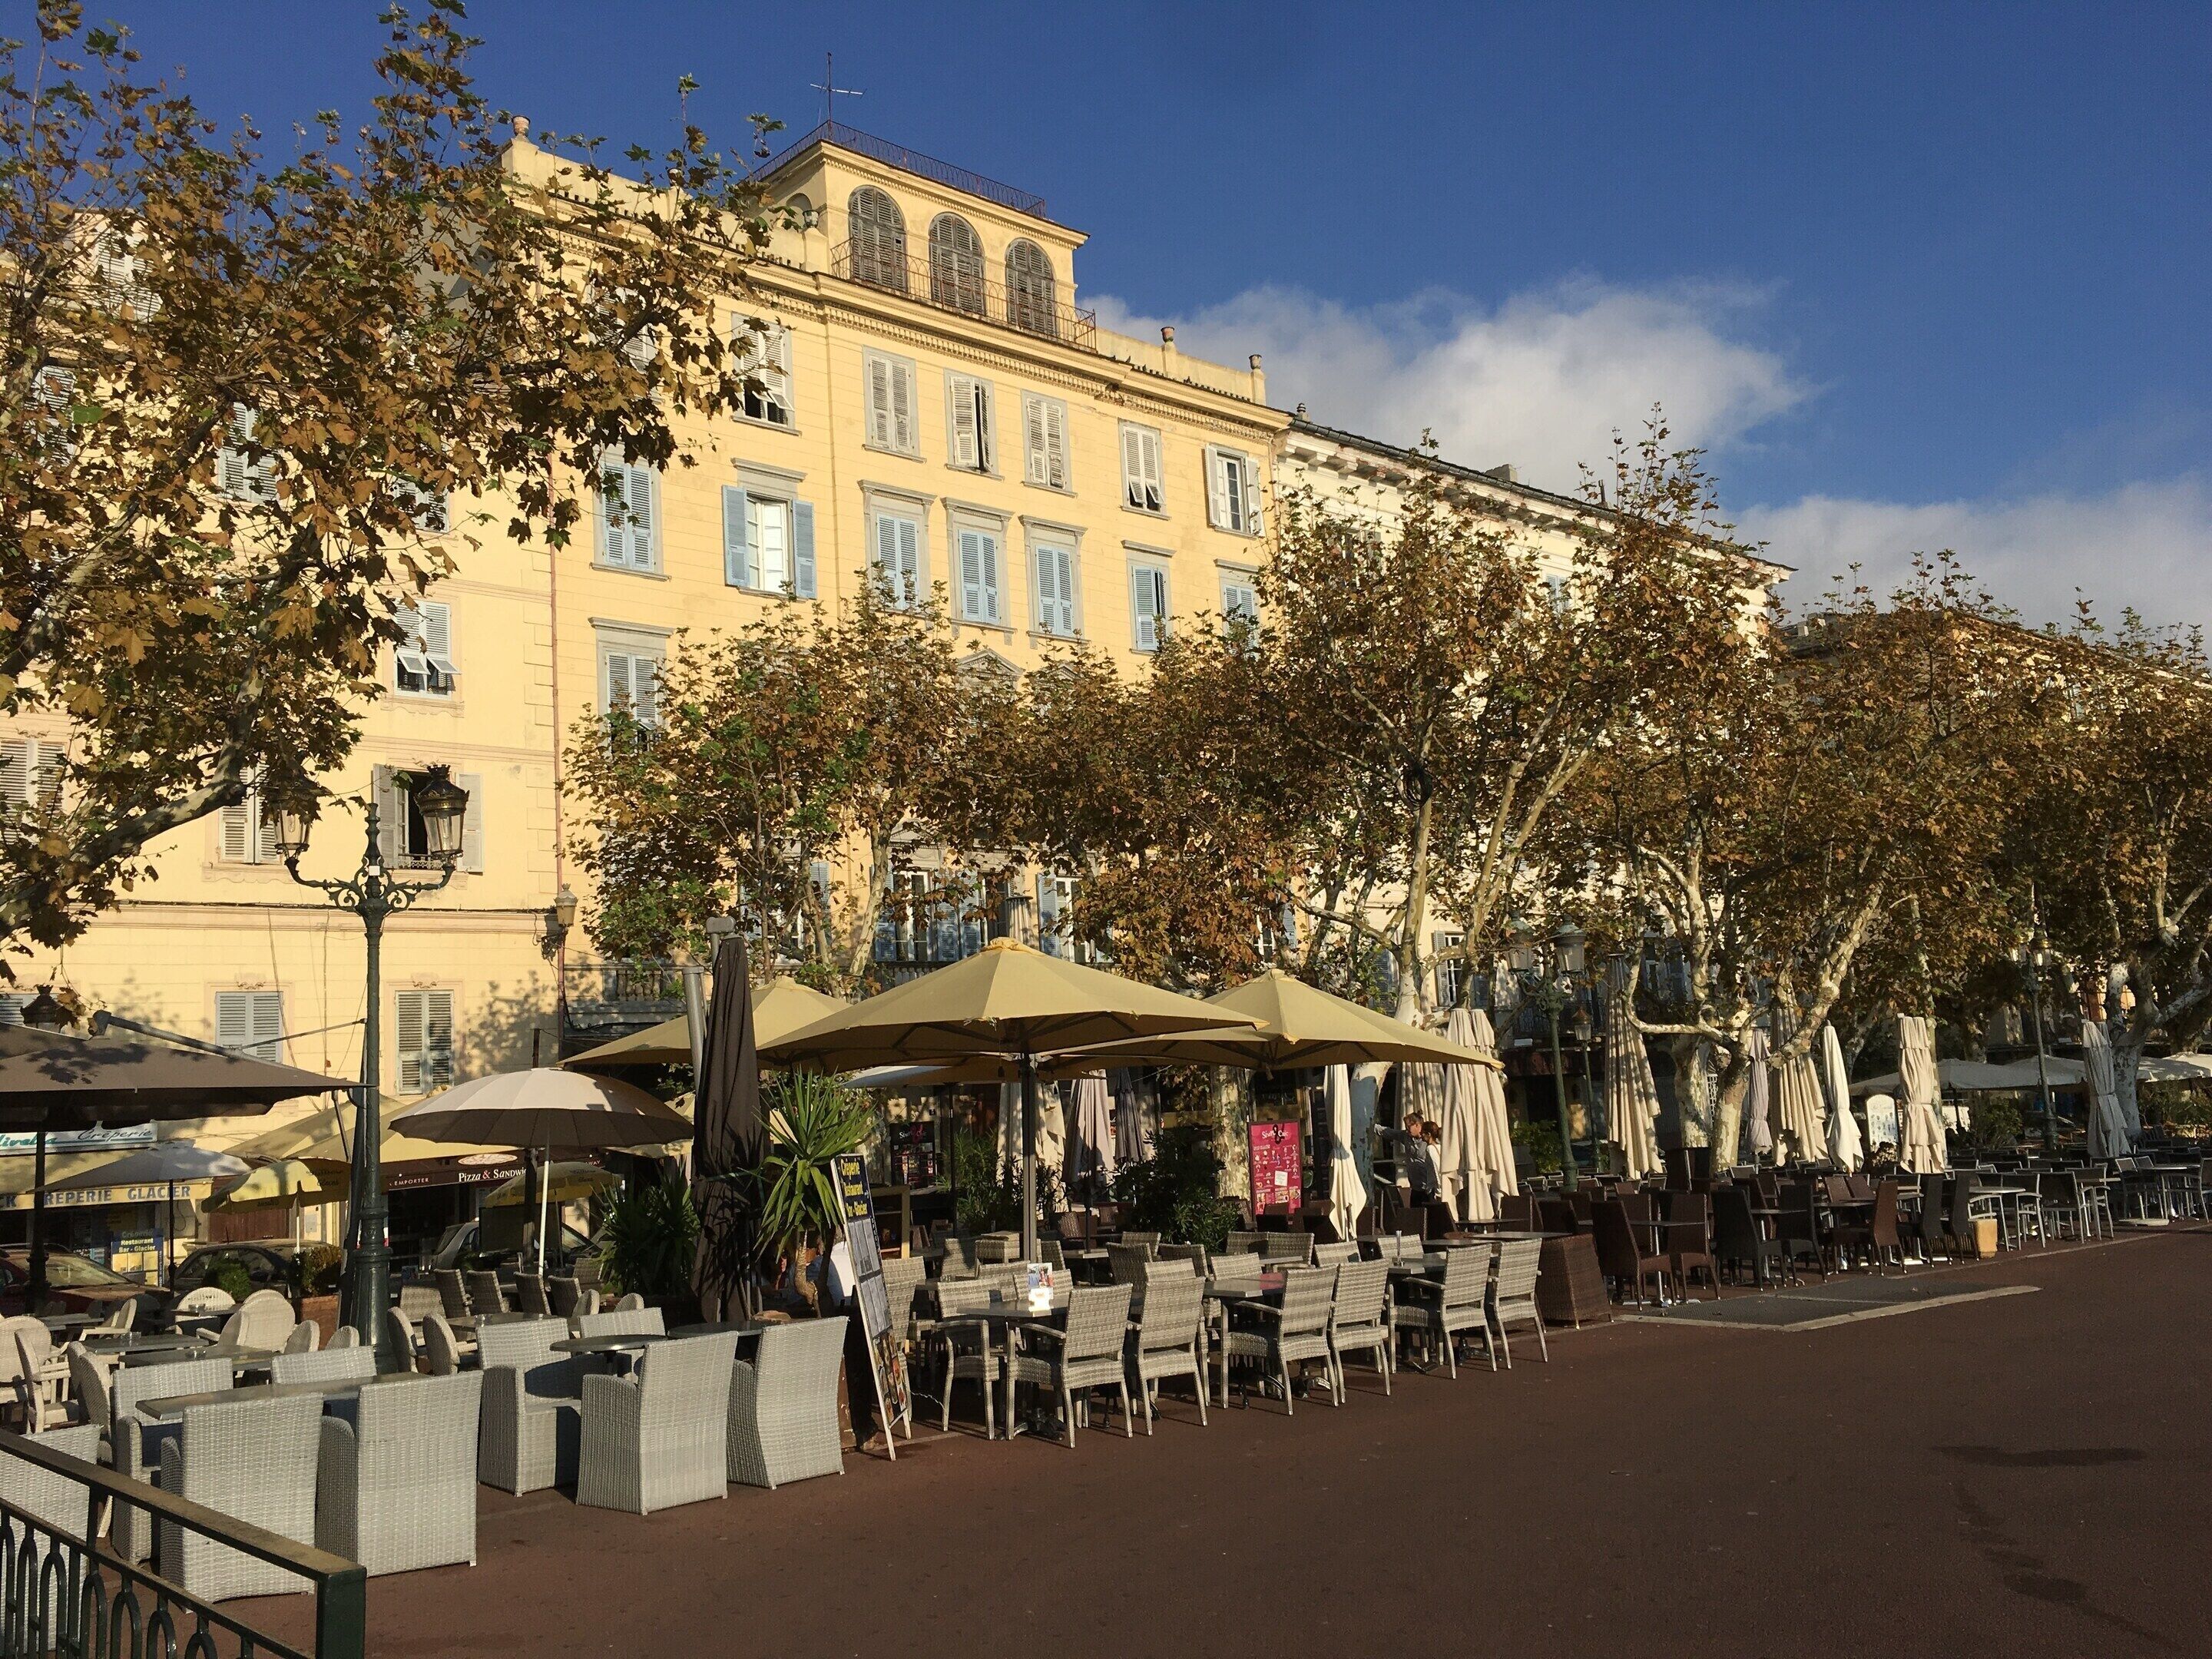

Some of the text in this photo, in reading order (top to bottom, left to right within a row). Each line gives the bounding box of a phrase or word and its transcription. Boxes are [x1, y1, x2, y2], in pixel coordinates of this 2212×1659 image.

[78, 1129, 153, 1142] Crêperie
[394, 1177, 429, 1186] EMPORTER
[459, 1172, 481, 1182] Pizza
[482, 1170, 491, 1179] &
[44, 1190, 112, 1206] REPERIE
